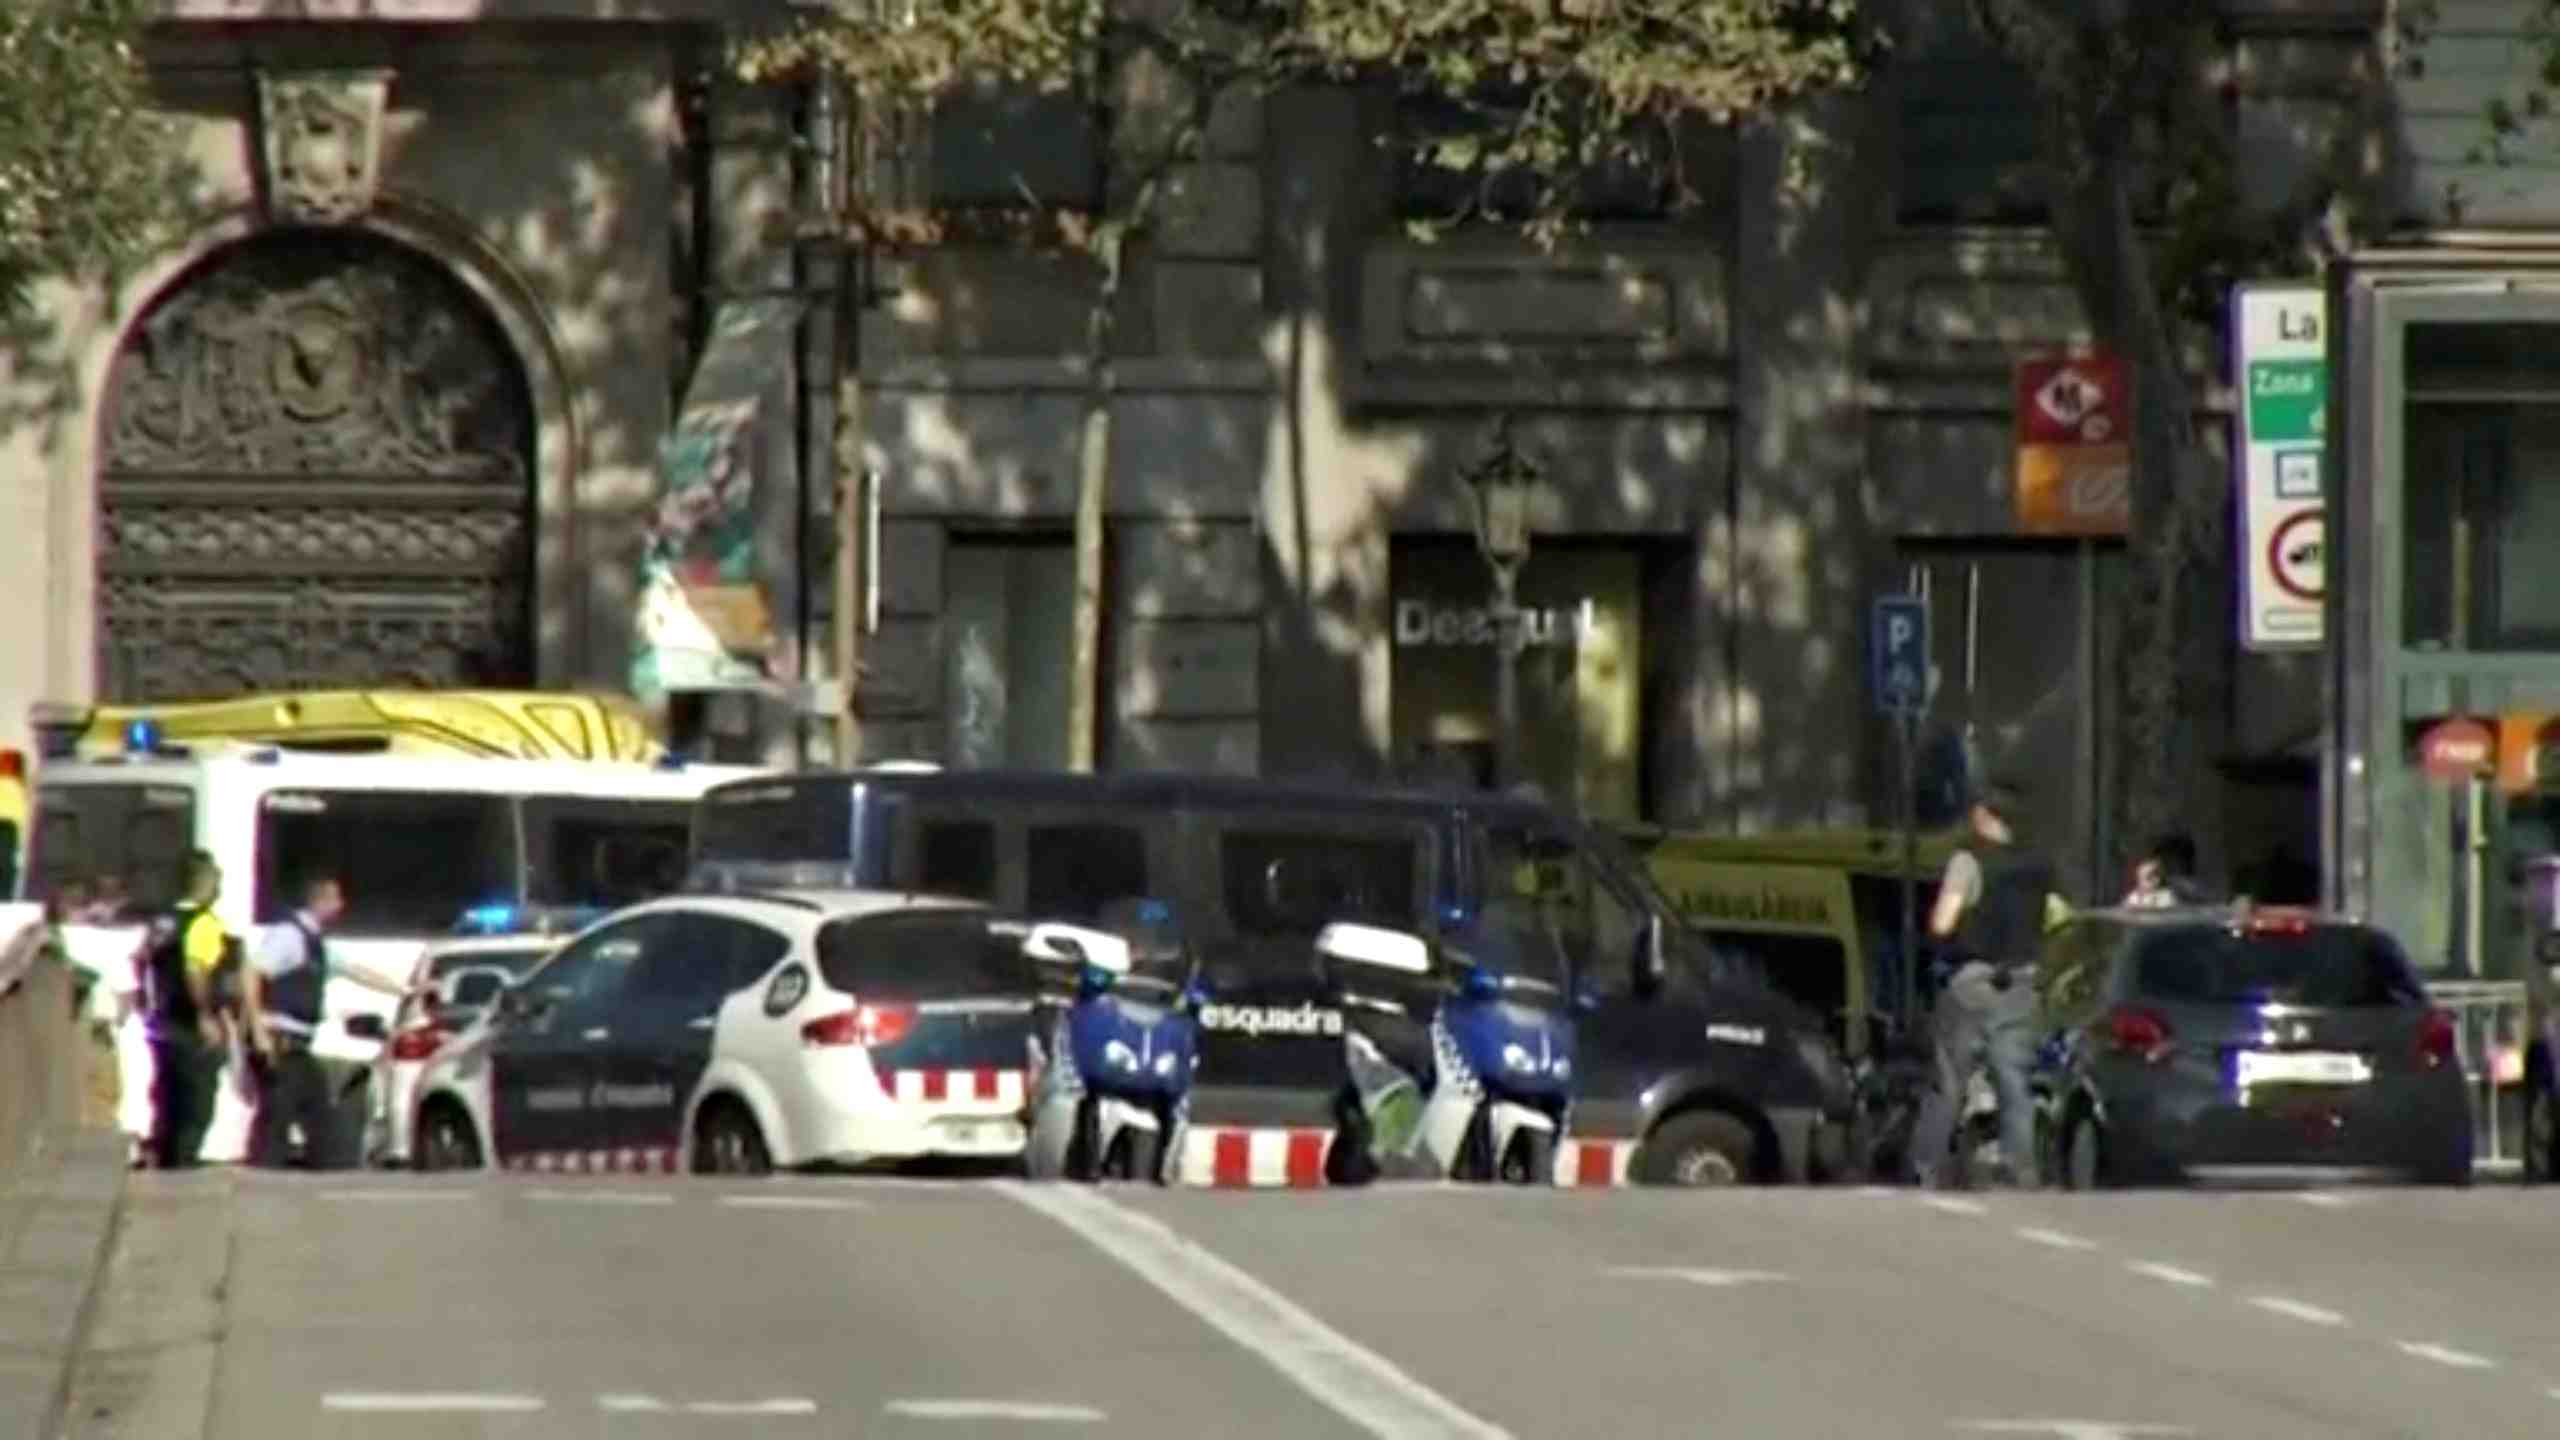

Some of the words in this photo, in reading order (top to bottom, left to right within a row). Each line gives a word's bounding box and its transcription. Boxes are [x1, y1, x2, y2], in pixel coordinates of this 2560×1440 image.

[2279, 308, 2318, 341] La
[1396, 599, 1595, 653] Desgual
[1889, 615, 1913, 653] P
[1199, 1001, 1343, 1037] esquadra
